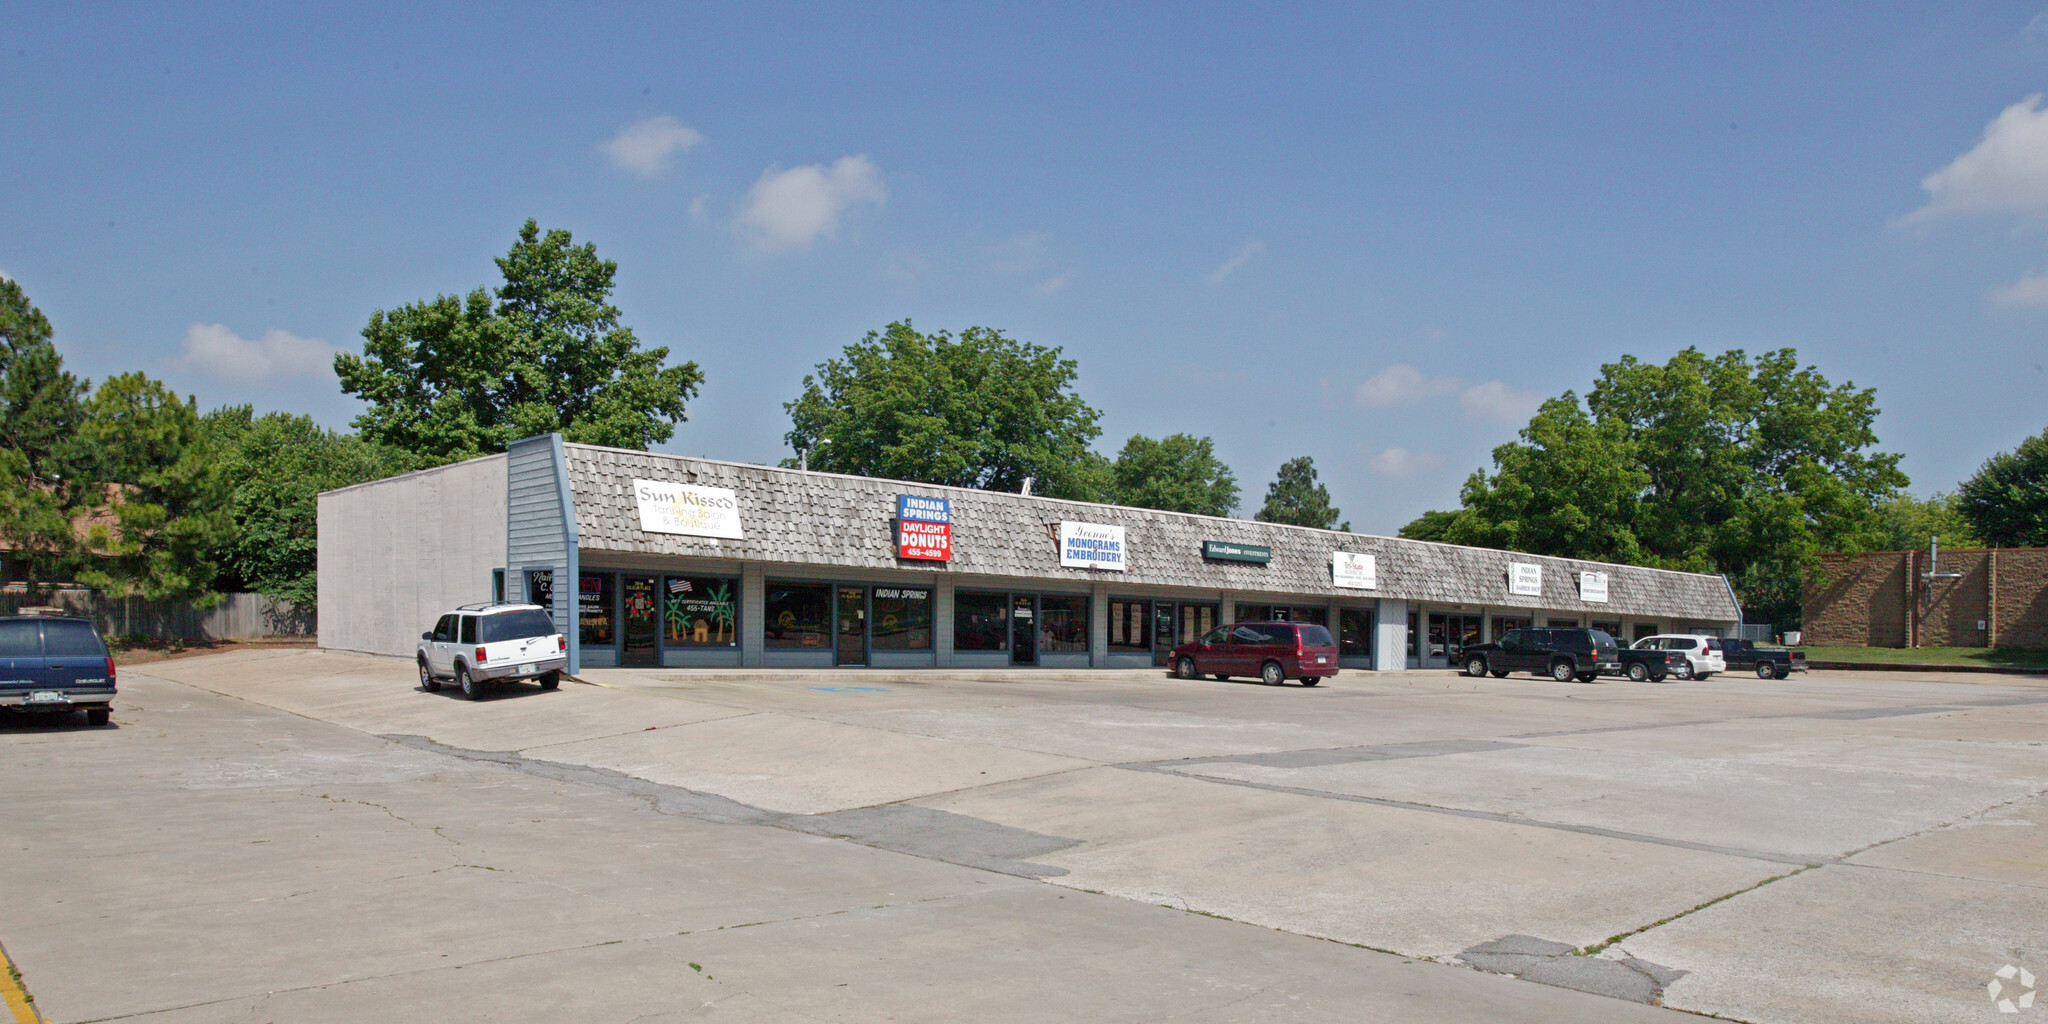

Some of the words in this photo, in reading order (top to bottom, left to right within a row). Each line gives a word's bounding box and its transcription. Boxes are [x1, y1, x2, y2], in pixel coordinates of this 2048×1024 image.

[640, 487, 676, 504] Sun
[681, 491, 734, 509] Kissed
[906, 498, 944, 511] INDIAN
[653, 504, 695, 519] Tanning
[698, 508, 727, 520] Salon
[903, 507, 948, 522] SPRINGS
[663, 516, 670, 526] &
[674, 517, 720, 530] Boutique
[903, 522, 946, 535] DAYLIGHT
[901, 532, 948, 549] DONUTS
[1067, 537, 1120, 552] MONOGRAMS
[908, 548, 942, 558] 455-4599
[875, 588, 901, 599] INDIAN
[901, 589, 928, 600] SPRINGS
